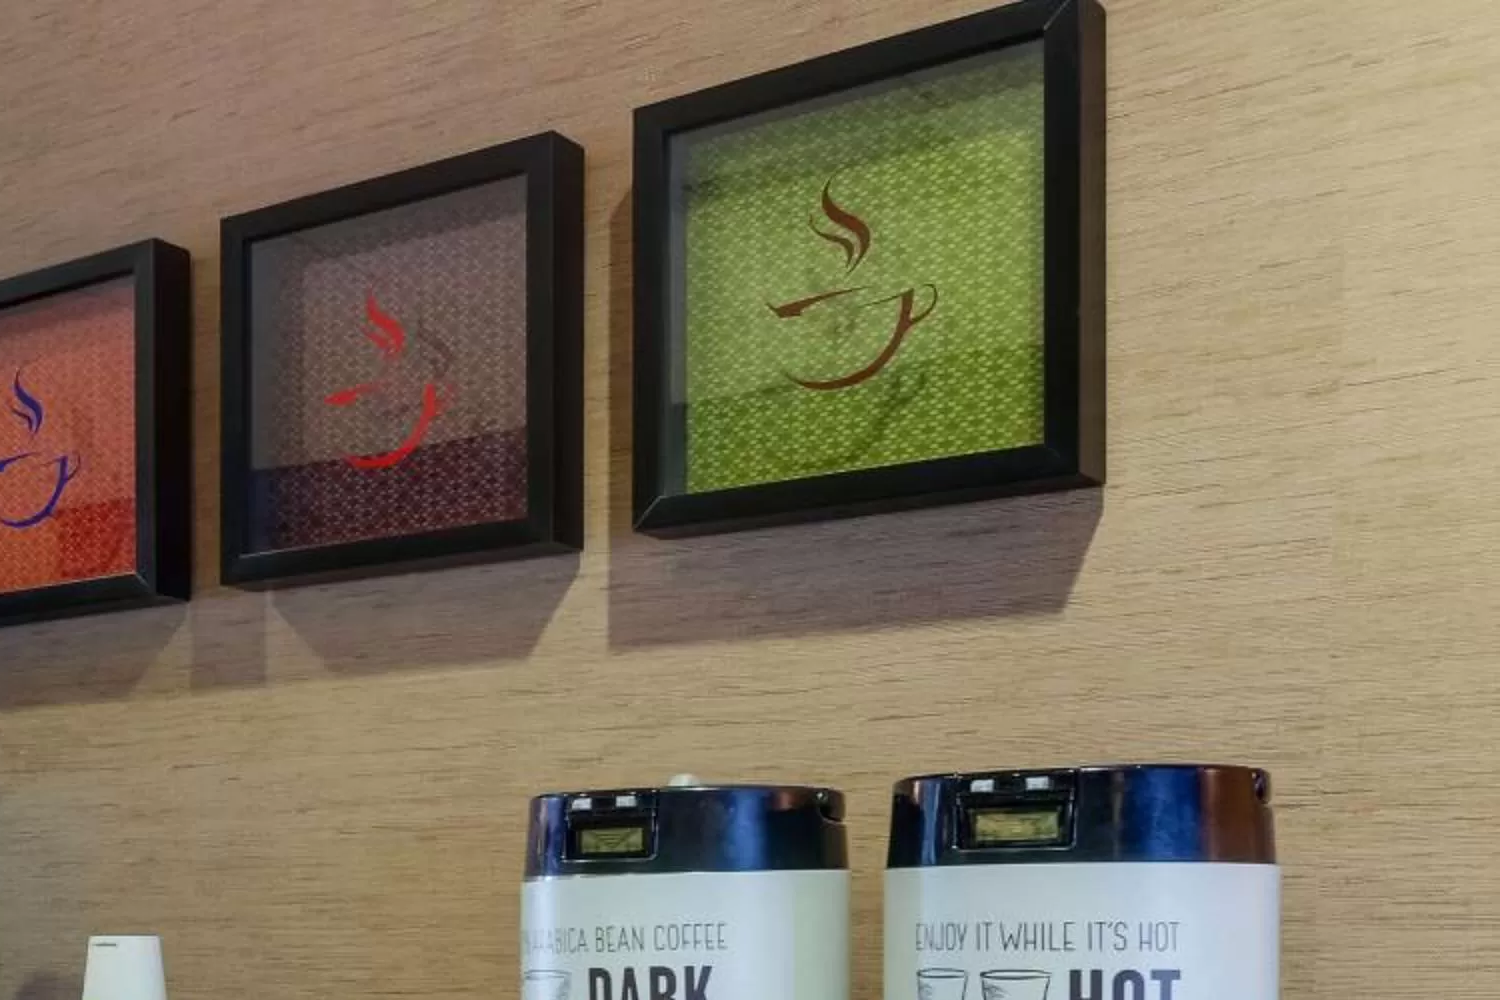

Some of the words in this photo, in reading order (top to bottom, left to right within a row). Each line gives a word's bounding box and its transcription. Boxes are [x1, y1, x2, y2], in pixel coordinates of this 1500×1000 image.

[595, 926, 645, 953] BEAN
[653, 923, 729, 951] COFFEE
[915, 921, 968, 951] ENJOY
[975, 921, 994, 952] IT
[1000, 920, 1077, 951] WHILE
[1087, 920, 1129, 951] IT'S
[1139, 921, 1182, 952] HOT
